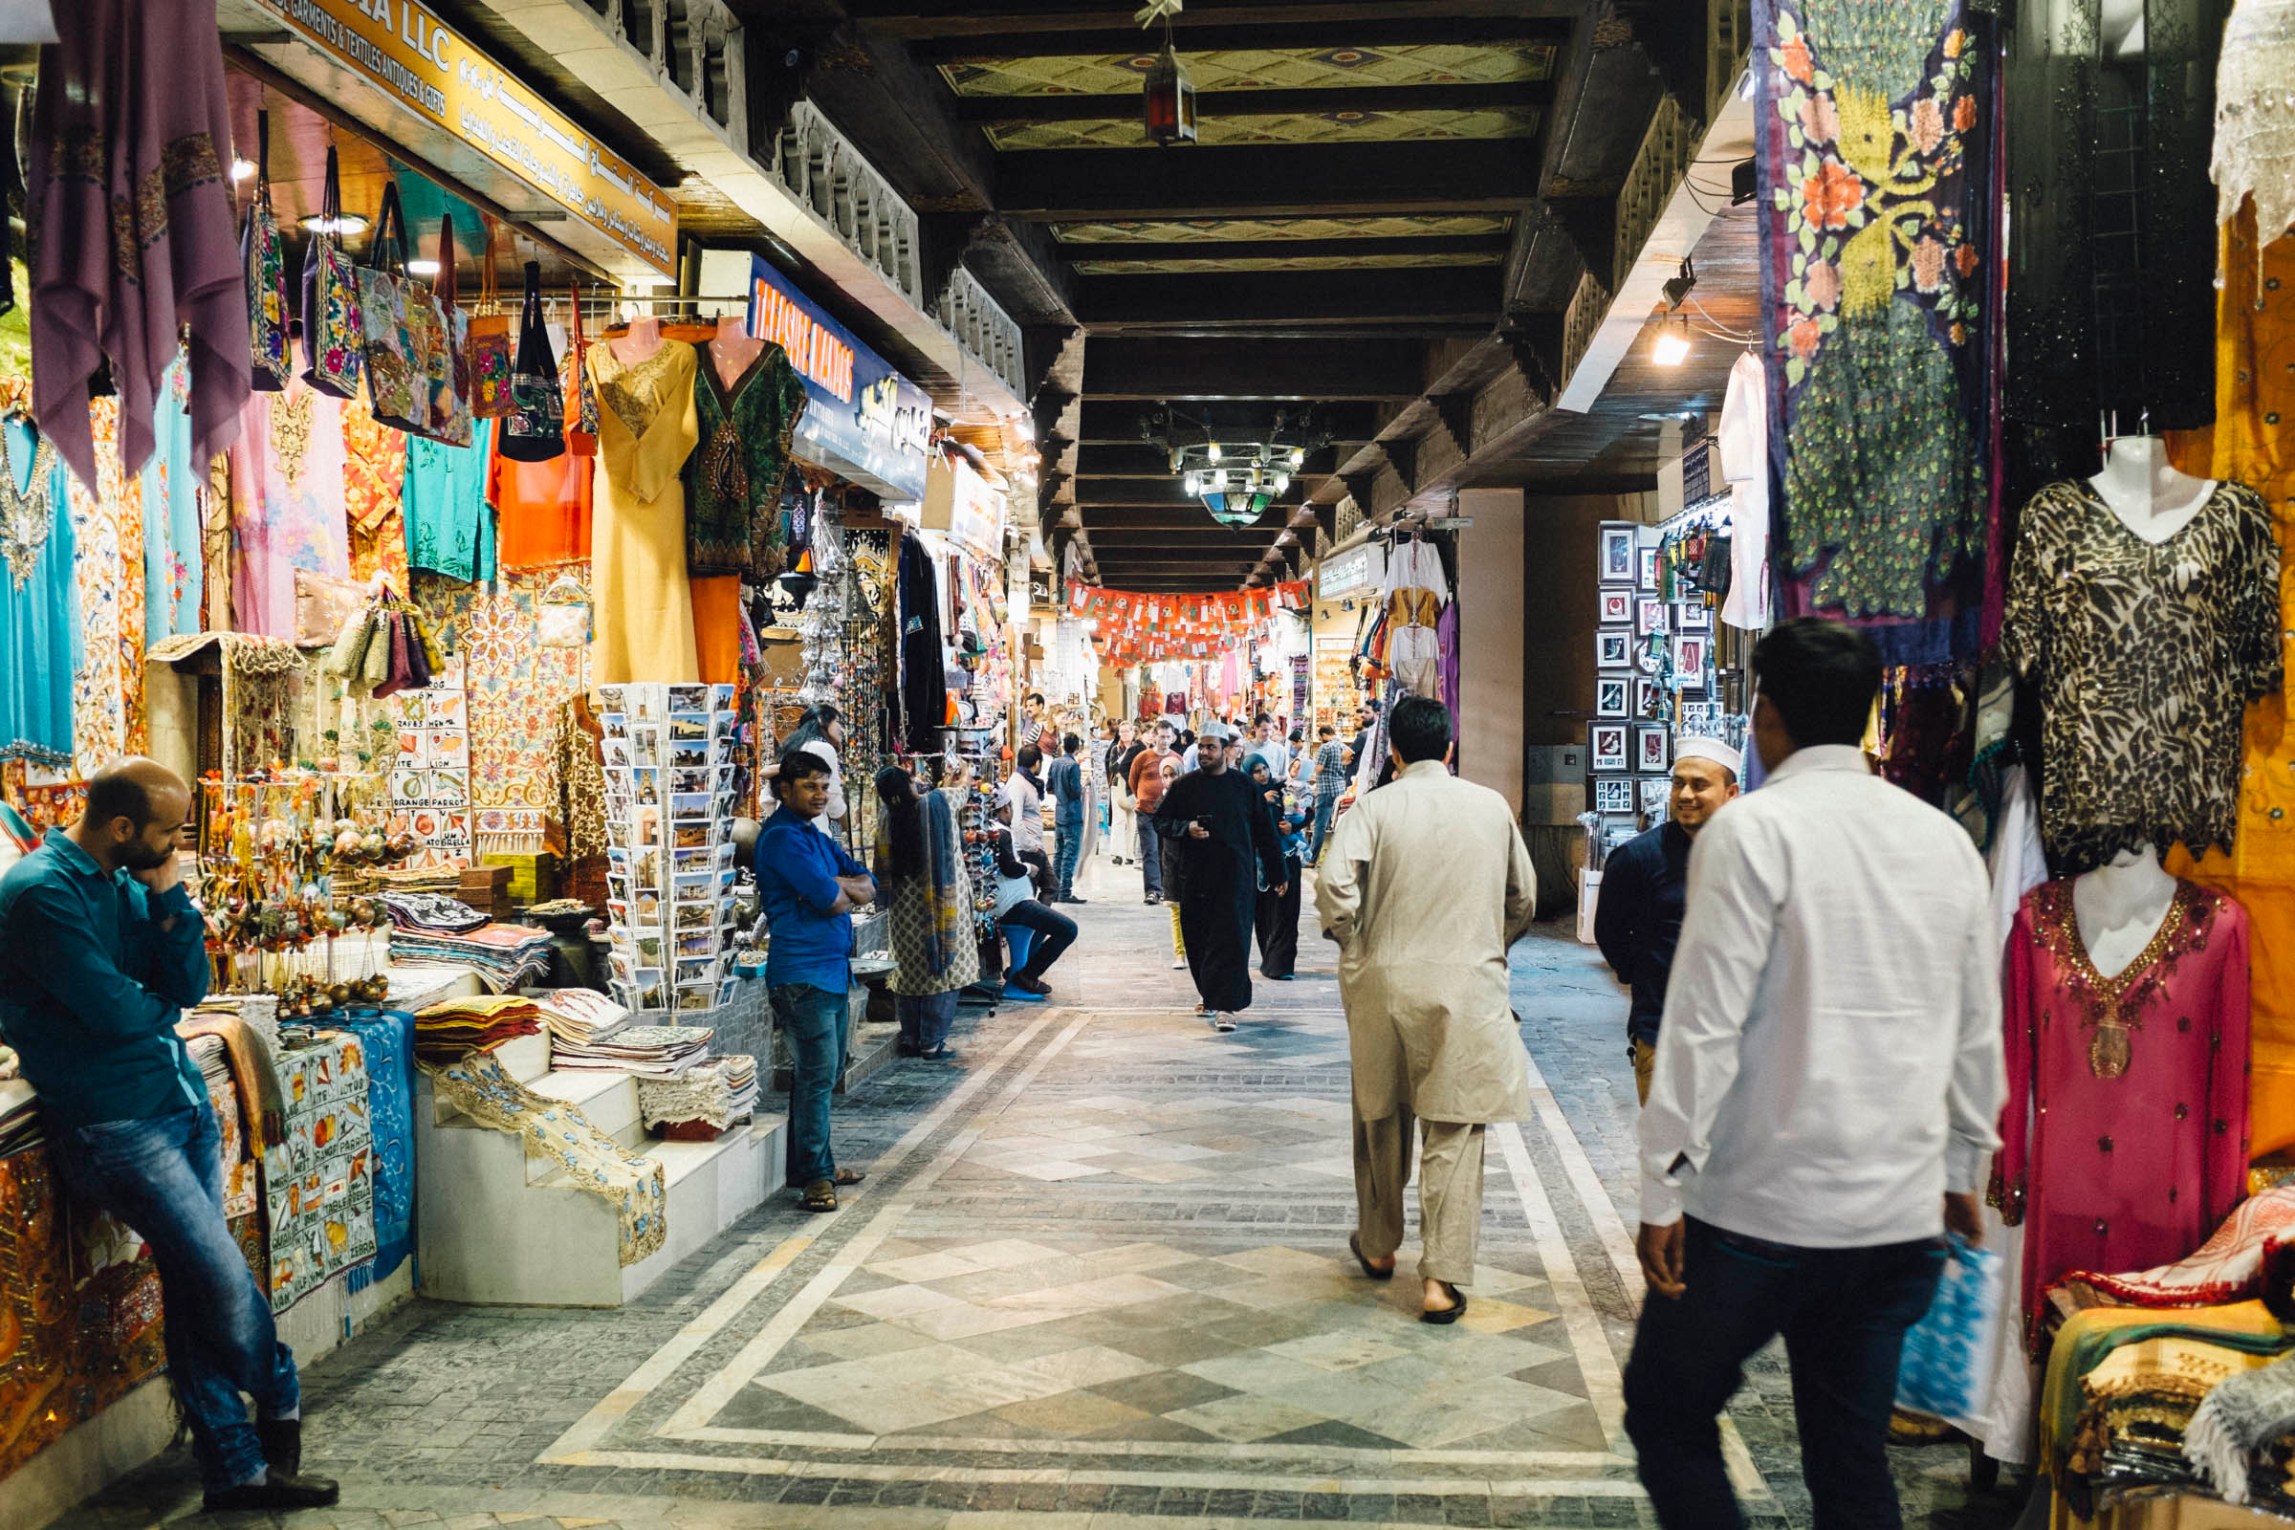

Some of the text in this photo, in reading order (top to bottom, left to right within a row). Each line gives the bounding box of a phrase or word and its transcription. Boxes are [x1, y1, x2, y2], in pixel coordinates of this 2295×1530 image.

[402, 1, 450, 73] LLC
[291, 0, 337, 45] GARMENTS
[337, 22, 346, 51] &
[346, 27, 382, 73] TEXTILES
[382, 51, 419, 98] ANTIQUES
[418, 79, 426, 104] &
[425, 83, 447, 118] GIFTS
[636, 179, 671, 225] شركة
[753, 277, 812, 376] TREASURE
[429, 760, 450, 768] LION
[393, 799, 430, 807] ORANGE
[431, 799, 465, 807] PARROT
[339, 1132, 371, 1153] PARROT
[350, 1240, 375, 1259] ZEBRA
[274, 1293, 290, 1310] VAN
